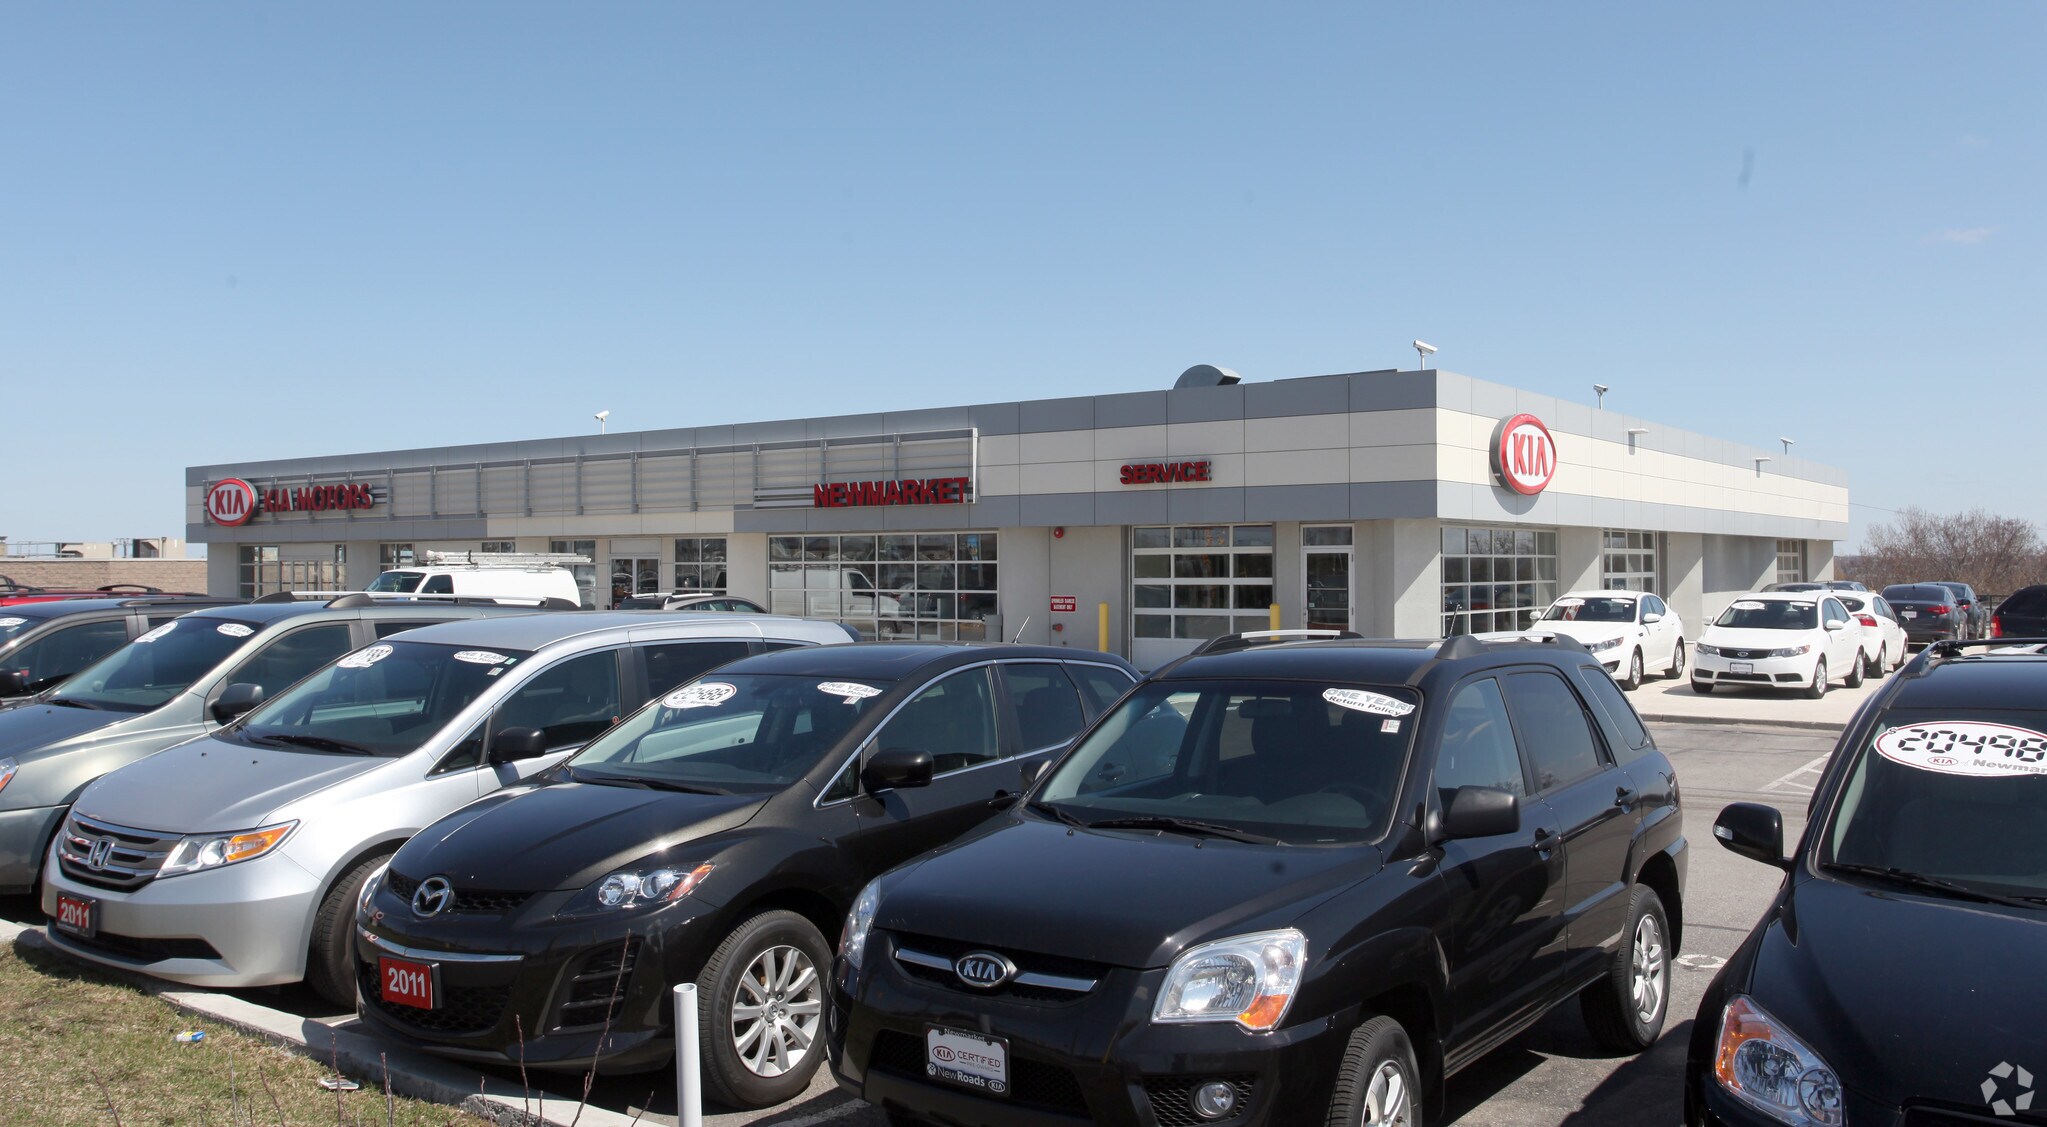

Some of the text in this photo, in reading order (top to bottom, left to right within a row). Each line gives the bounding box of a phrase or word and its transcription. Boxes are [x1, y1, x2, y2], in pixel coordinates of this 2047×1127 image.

[1512, 432, 1548, 477] KIA
[1120, 461, 1210, 484] SERVICE
[215, 489, 245, 515] KIA
[264, 483, 373, 513] KIA MOTORS
[814, 477, 968, 508] NEWMARKET
[1326, 688, 1361, 700] ONE
[1328, 696, 1402, 716] Return Policy
[1898, 728, 2047, 763] 20498
[61, 902, 90, 928] 2011
[963, 959, 996, 981] KIA
[388, 967, 426, 998] 2011
[944, 1028, 985, 1042] Newmarket
[936, 1048, 1001, 1068] KIA CERTIFIED
[990, 1081, 1003, 1092] KIA
